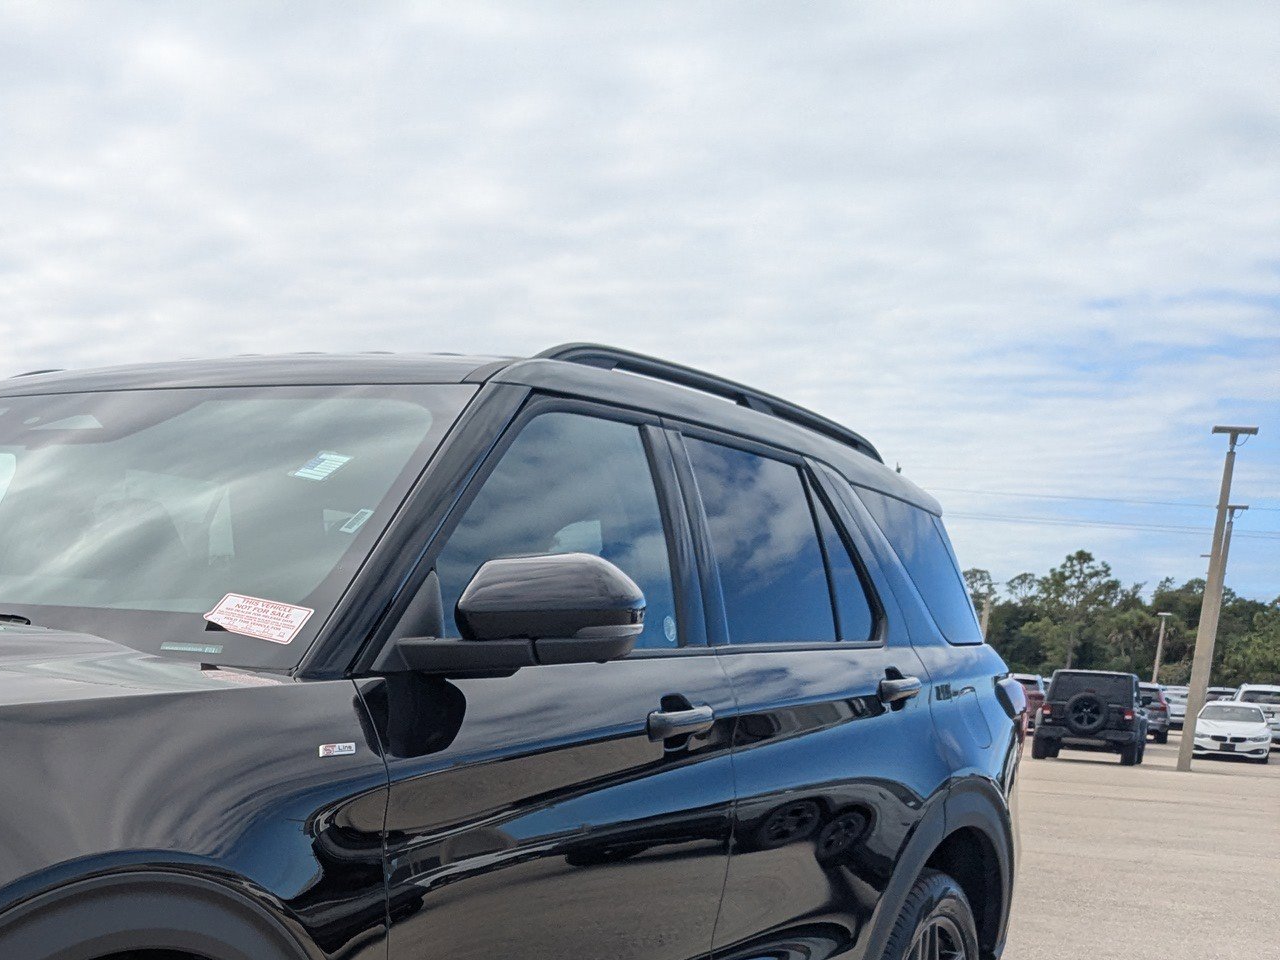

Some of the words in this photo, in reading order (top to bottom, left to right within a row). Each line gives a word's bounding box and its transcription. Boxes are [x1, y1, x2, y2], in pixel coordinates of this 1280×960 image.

[234, 603, 252, 611] NOT
[252, 606, 269, 615] FOR
[270, 610, 292, 620] SALE
[242, 598, 259, 607] THIS
[261, 601, 294, 614] VEHICLE
